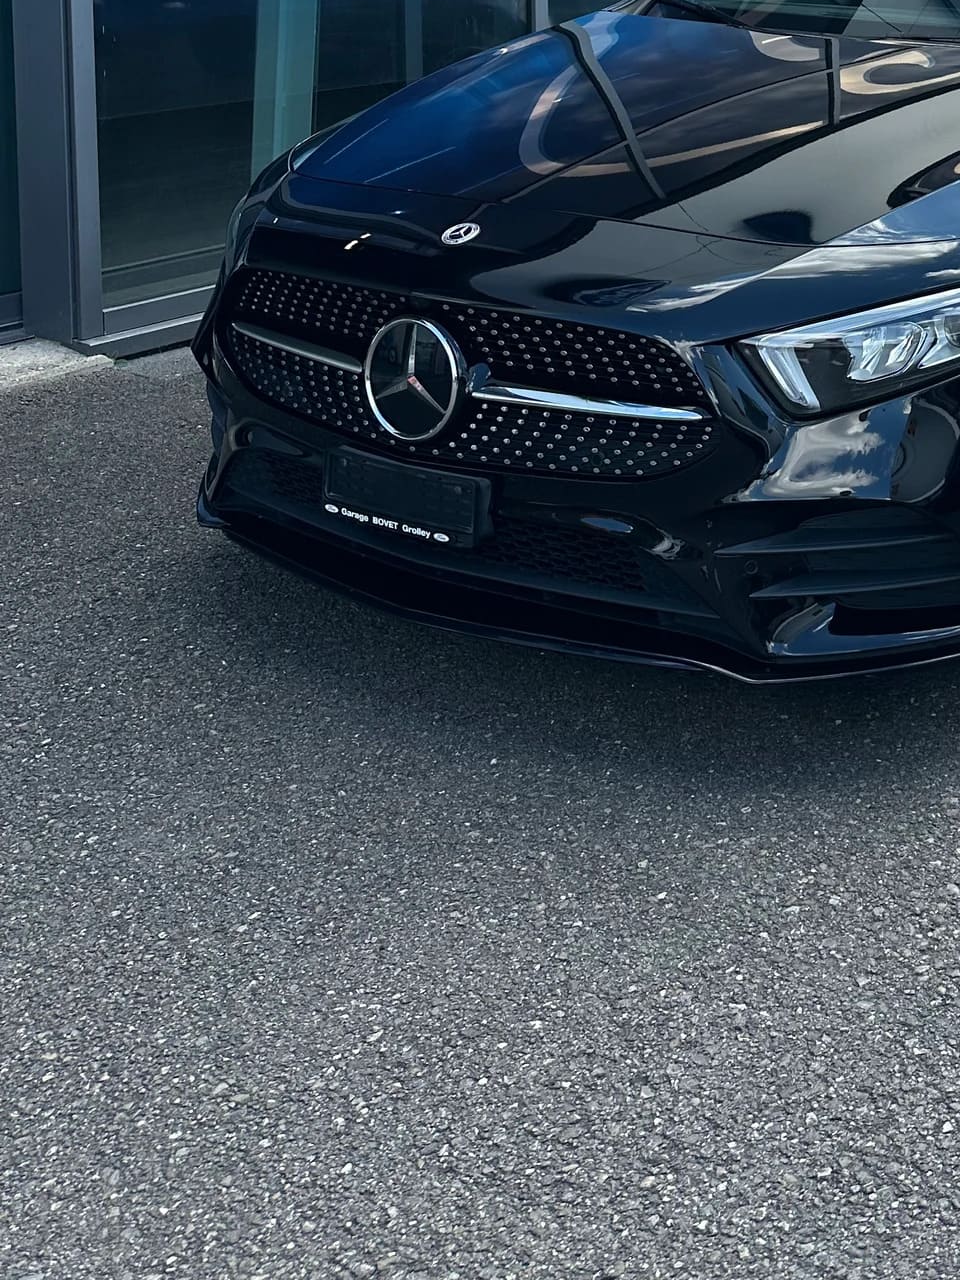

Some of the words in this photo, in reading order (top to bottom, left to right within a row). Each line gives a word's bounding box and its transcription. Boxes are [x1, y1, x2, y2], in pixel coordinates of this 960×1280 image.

[341, 507, 369, 522] Garage
[372, 516, 399, 530] BOVET
[402, 524, 431, 539] Grolley
